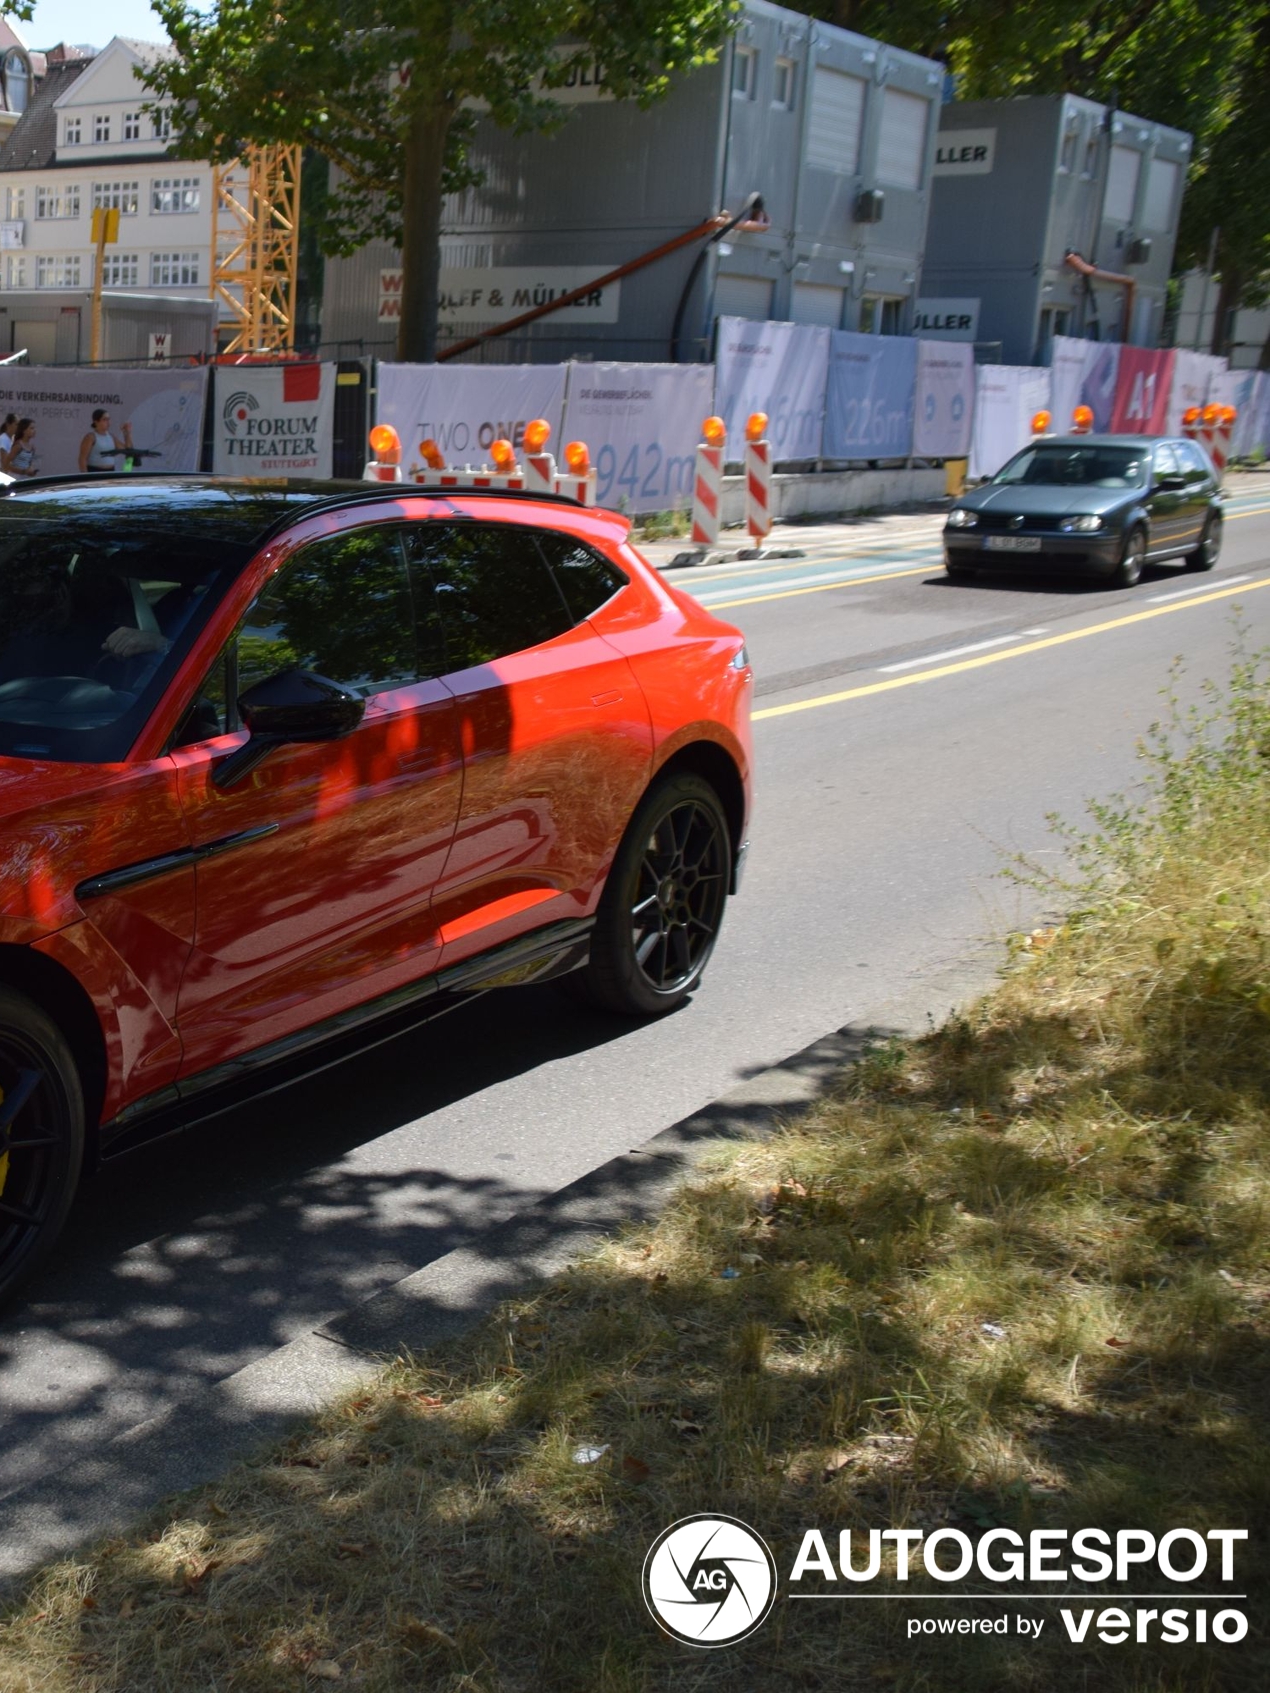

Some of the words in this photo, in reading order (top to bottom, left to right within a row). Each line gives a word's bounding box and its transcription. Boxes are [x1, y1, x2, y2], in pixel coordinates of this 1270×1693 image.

[936, 146, 988, 164] LLER
[488, 288, 503, 307] &
[1126, 371, 1157, 420] A1
[246, 416, 318, 436] FORUM
[225, 438, 318, 456] THEATER
